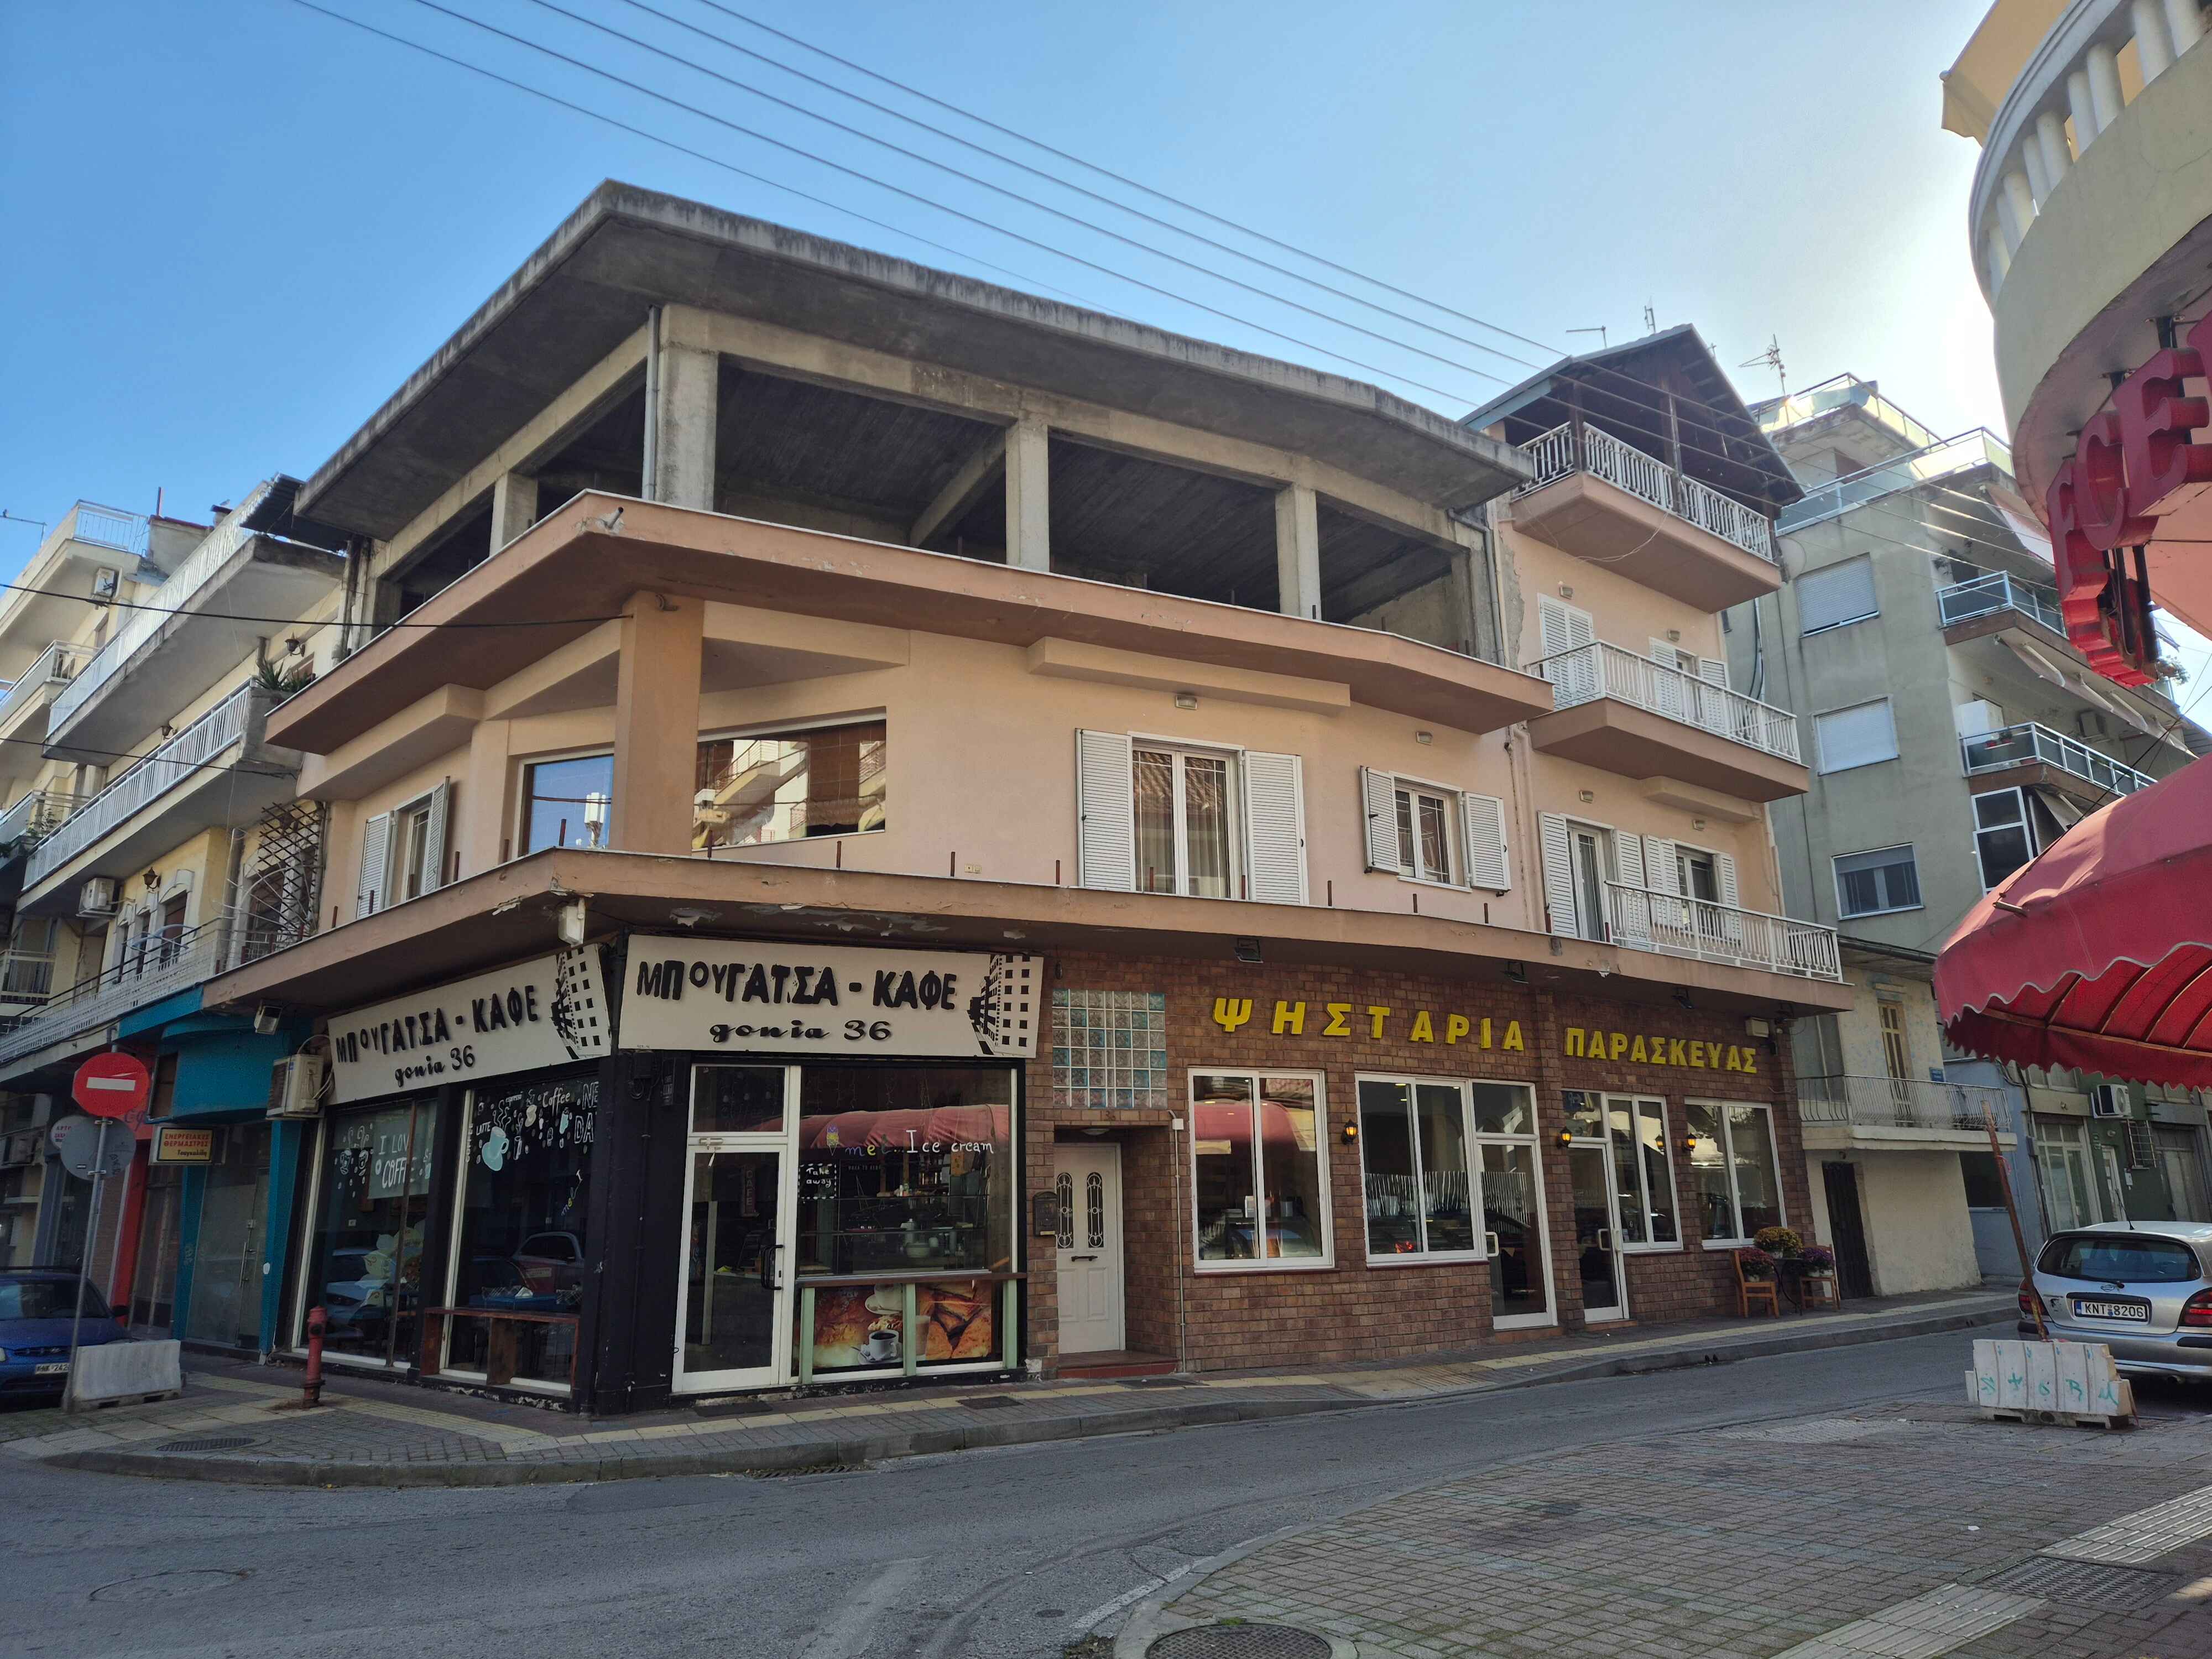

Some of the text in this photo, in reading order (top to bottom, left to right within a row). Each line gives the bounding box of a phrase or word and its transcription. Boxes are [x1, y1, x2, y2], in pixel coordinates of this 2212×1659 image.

[637, 960, 838, 1006] ΜΠΟΥΓΑΤΣΑ
[873, 969, 957, 1010] ΚΑΦΕ
[336, 1008, 450, 1063] ΜΠΟΥΓΑΤΣΑ
[471, 984, 538, 1034] ΚΑΦΕ
[709, 1020, 892, 1044] gonia 36
[1565, 1027, 1757, 1073] ΠΑΡΑΣΚΕΥΑΣ
[394, 1045, 475, 1088] gonia 36
[542, 1087, 570, 1116] Coffee
[476, 1121, 491, 1136] LATTE
[378, 1133, 410, 1155] I LOV
[906, 1130, 941, 1154] Ice
[951, 1140, 994, 1155] cream
[806, 1166, 831, 1176] Take
[806, 1178, 832, 1188] away
[2085, 1303, 2144, 1317] KNT 8206
